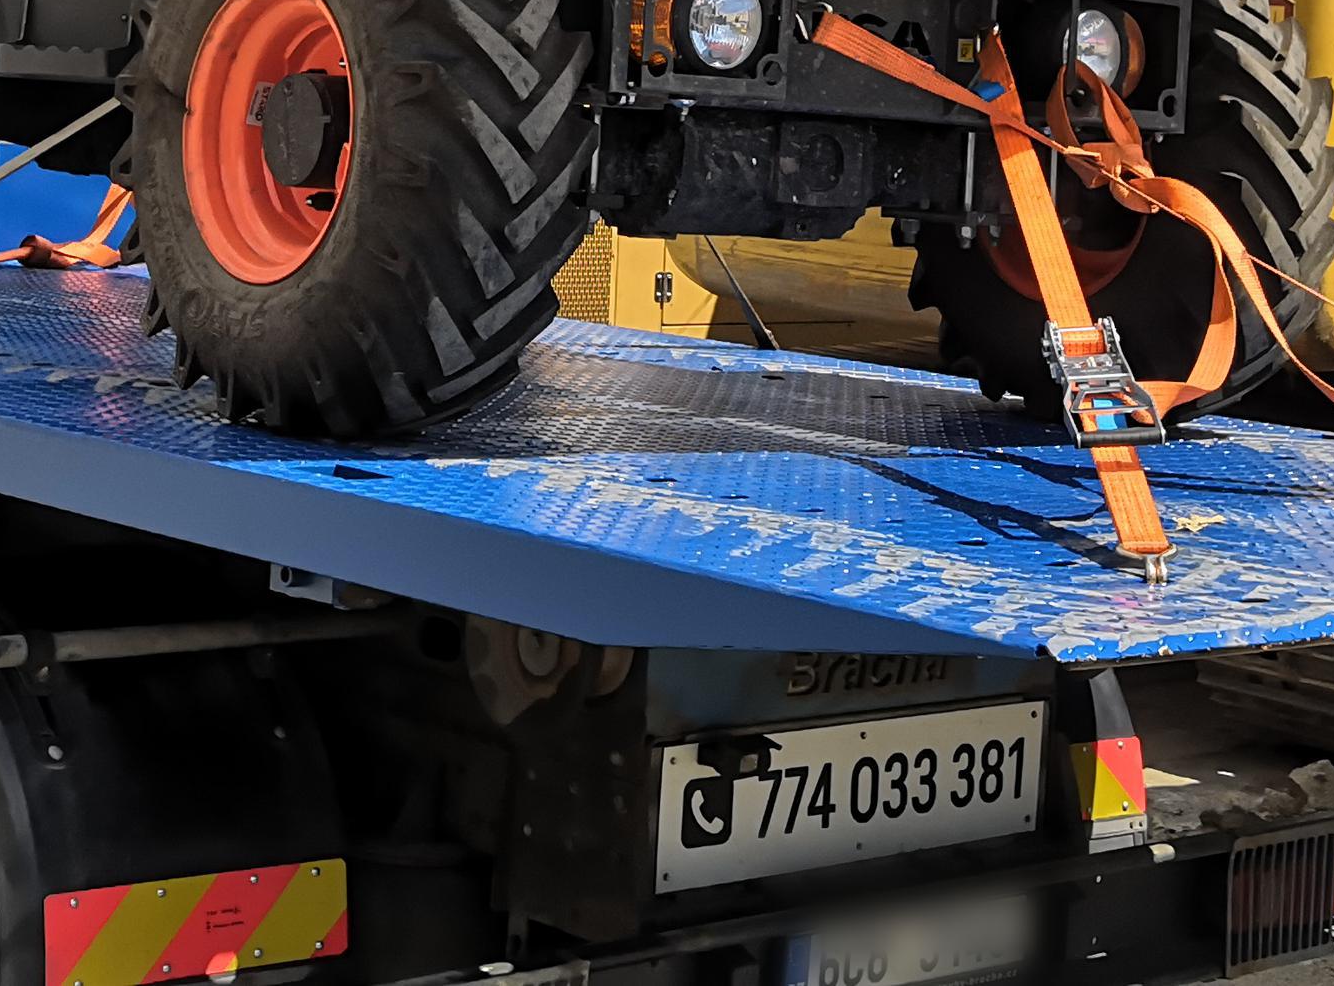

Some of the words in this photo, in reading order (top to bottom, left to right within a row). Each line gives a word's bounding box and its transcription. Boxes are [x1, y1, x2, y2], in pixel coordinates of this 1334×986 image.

[757, 762, 836, 838] 774
[850, 748, 938, 824] 033
[950, 736, 1025, 808] 381
